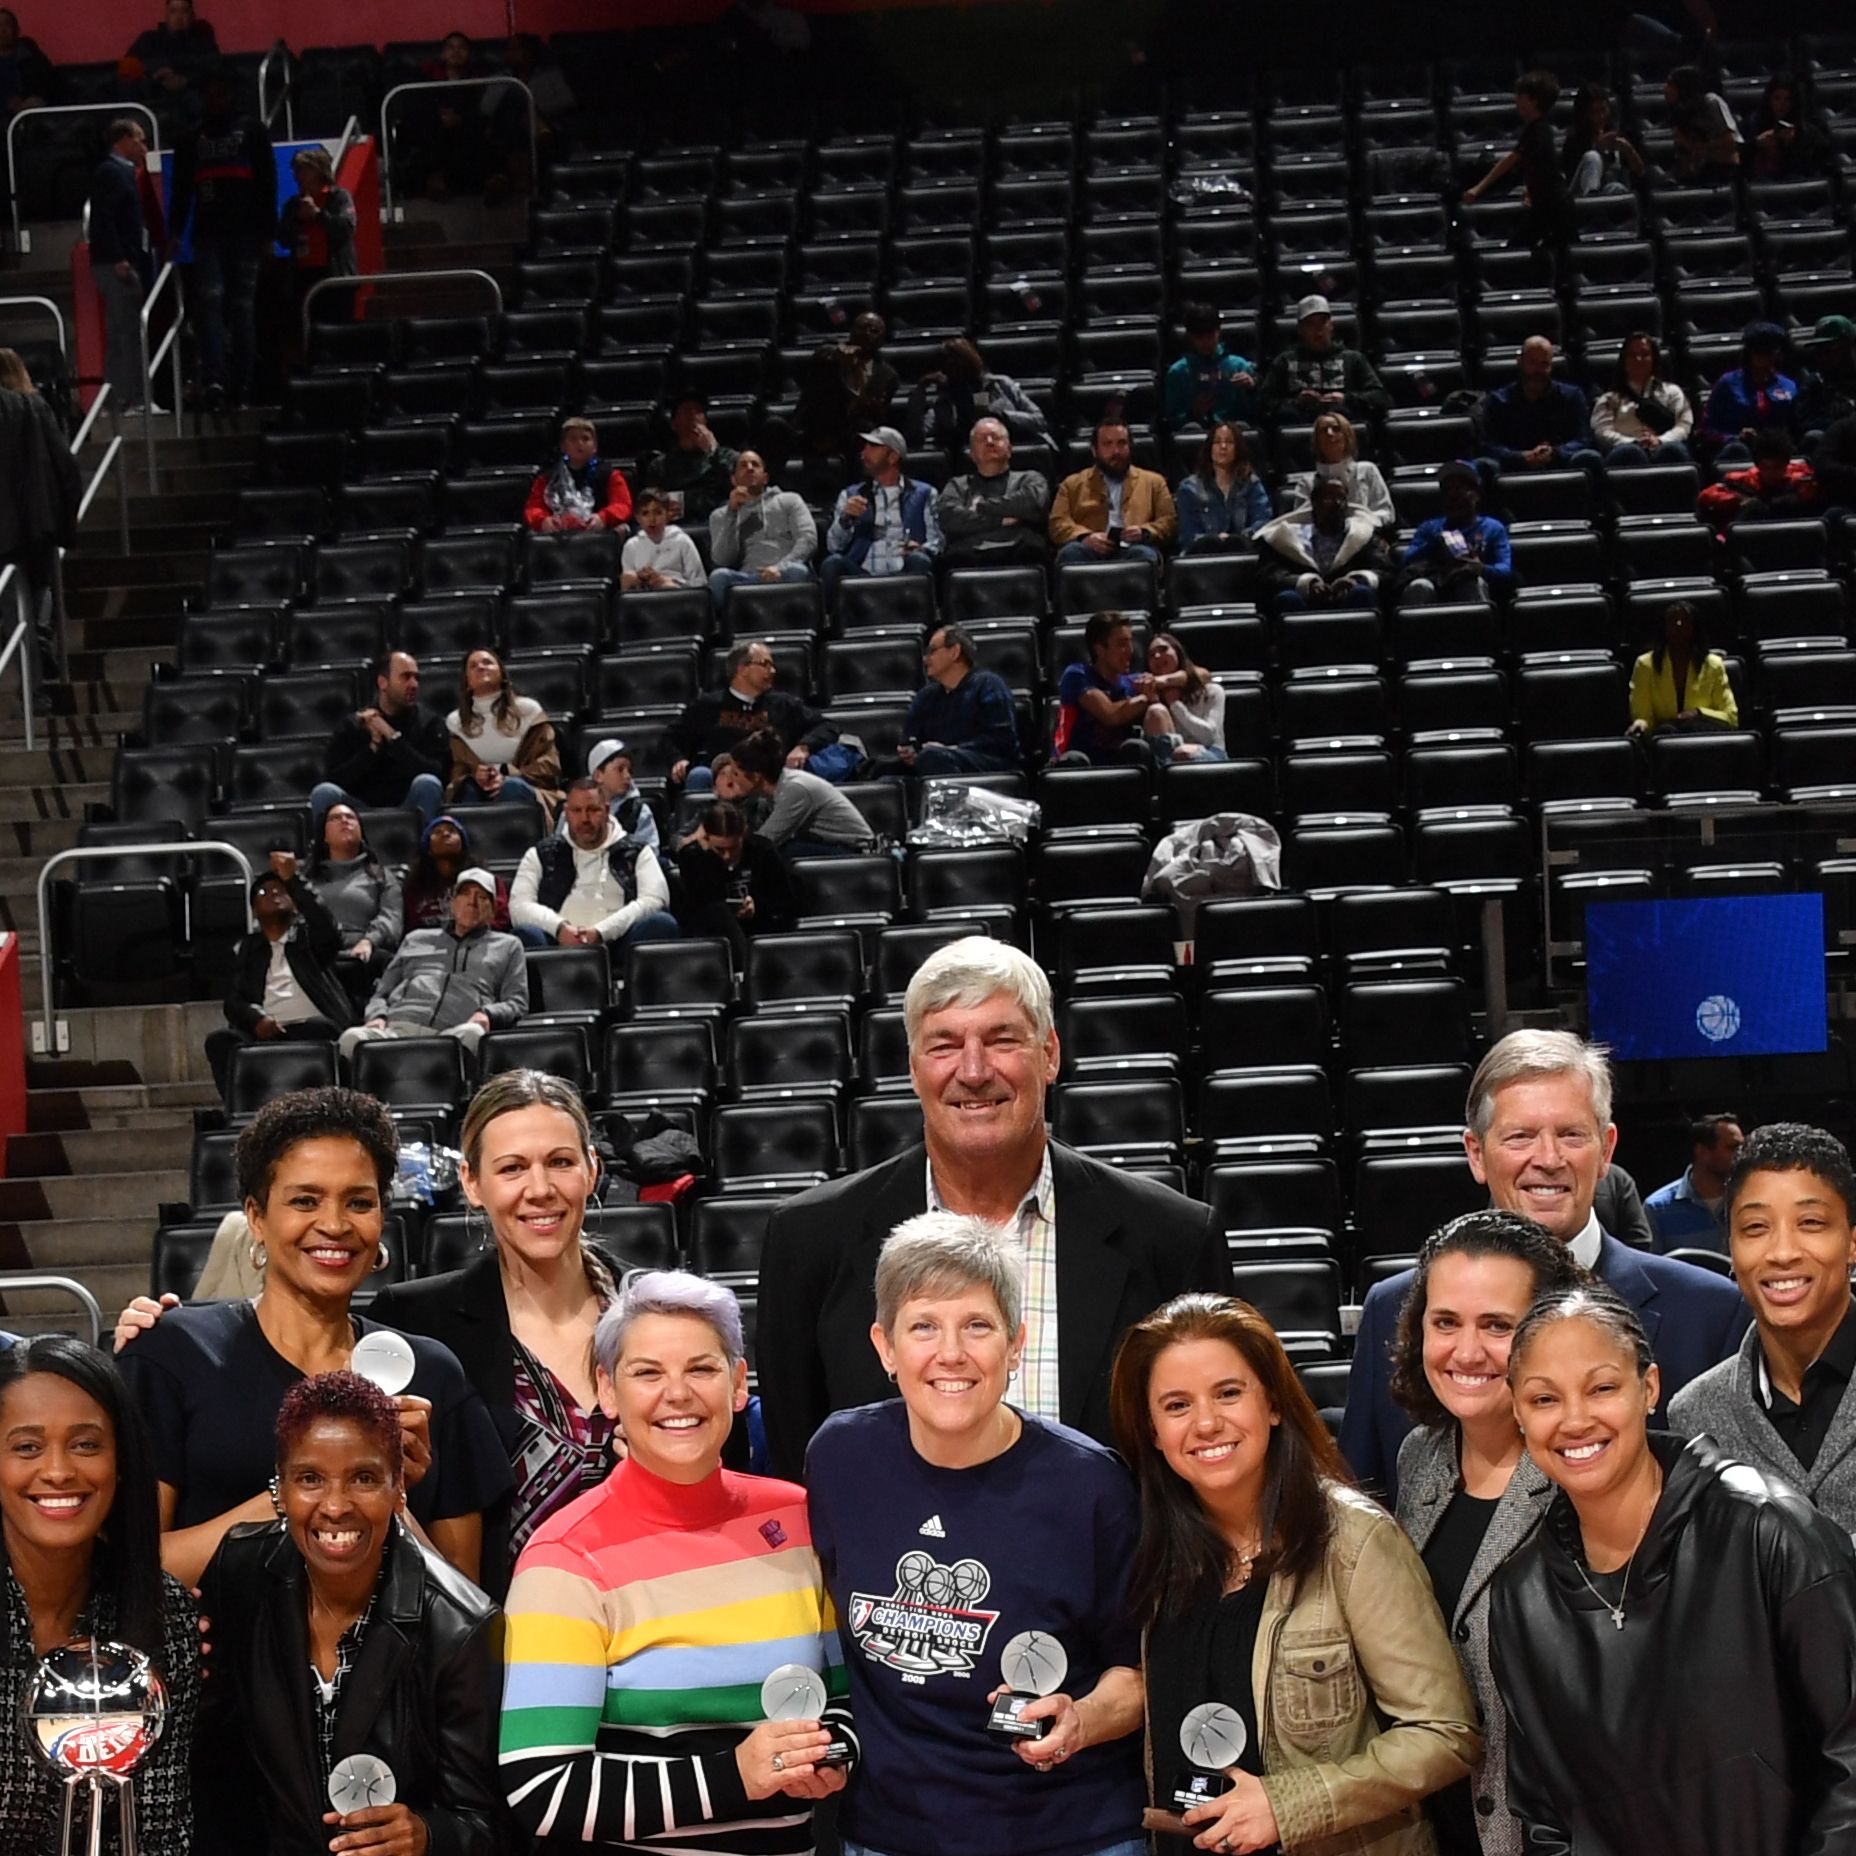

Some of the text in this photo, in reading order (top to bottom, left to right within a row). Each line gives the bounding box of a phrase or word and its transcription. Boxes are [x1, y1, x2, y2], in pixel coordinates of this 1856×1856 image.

[871, 1606, 982, 1641] CHAMPIONS
[882, 1626, 975, 1650] DETROIT SHOCK
